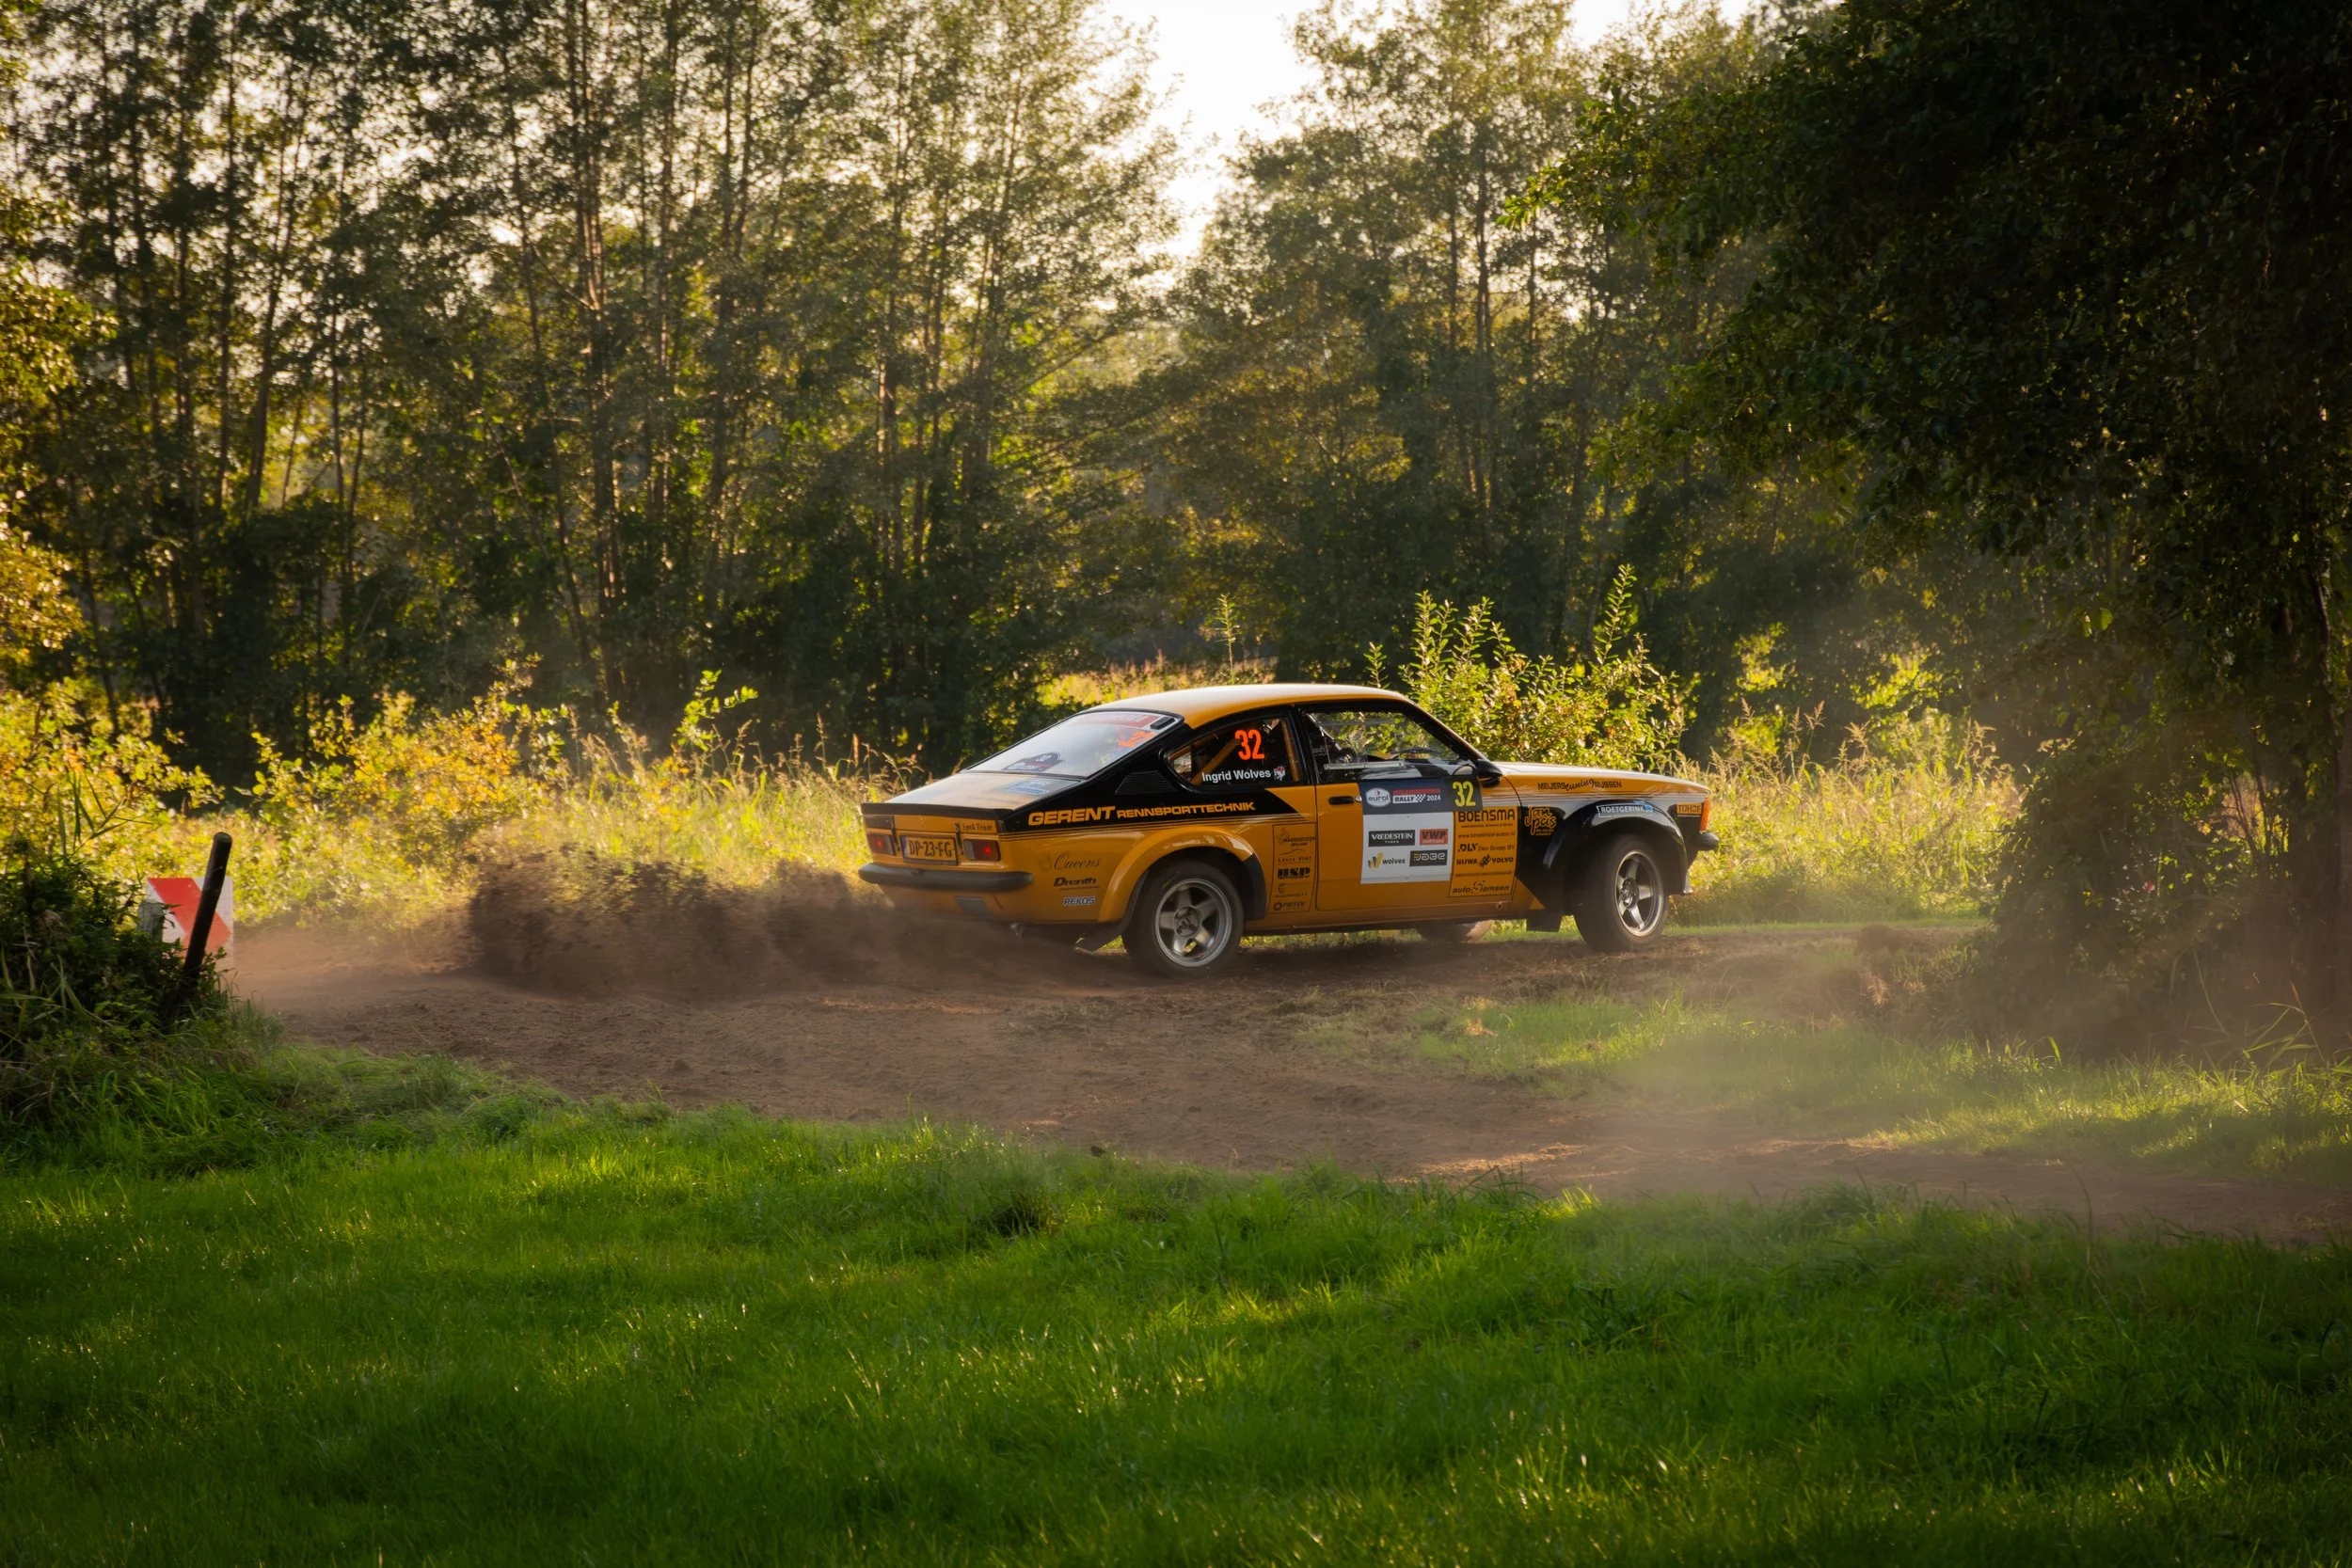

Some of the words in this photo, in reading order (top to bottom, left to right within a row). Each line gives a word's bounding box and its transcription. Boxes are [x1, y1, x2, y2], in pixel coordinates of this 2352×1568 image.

[1234, 729, 1264, 760] 32
[1201, 770, 1232, 784] Ingrid
[1233, 768, 1270, 780] Wolves
[1452, 781, 1476, 807] 32
[1027, 806, 1116, 826] GERENT
[1117, 801, 1256, 818] RENNSPORTTECHNIK
[1422, 831, 1447, 840] VWP
[1064, 896, 1095, 906] REKOS
